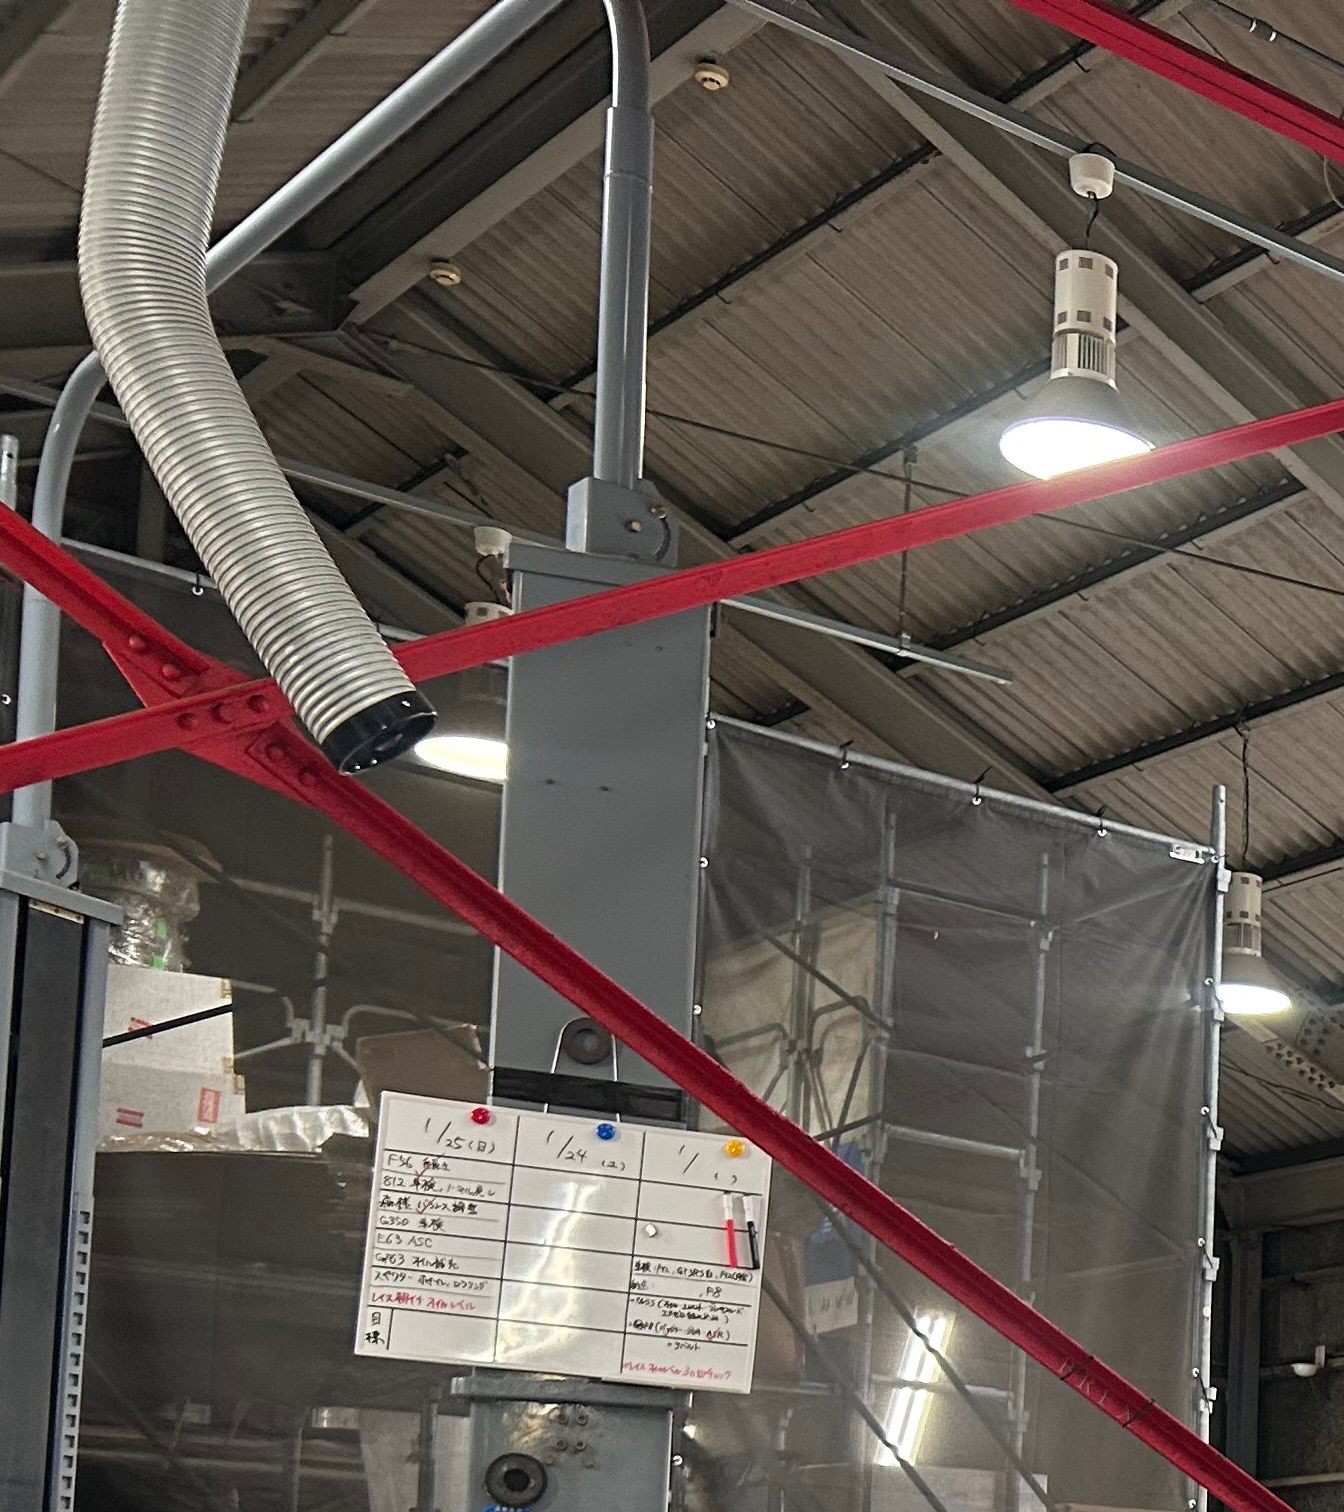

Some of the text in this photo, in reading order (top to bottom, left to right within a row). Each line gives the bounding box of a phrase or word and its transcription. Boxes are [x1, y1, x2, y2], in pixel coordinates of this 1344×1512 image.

[383, 1175, 405, 1188] 812
[376, 1233, 433, 1249] E63 ASC
